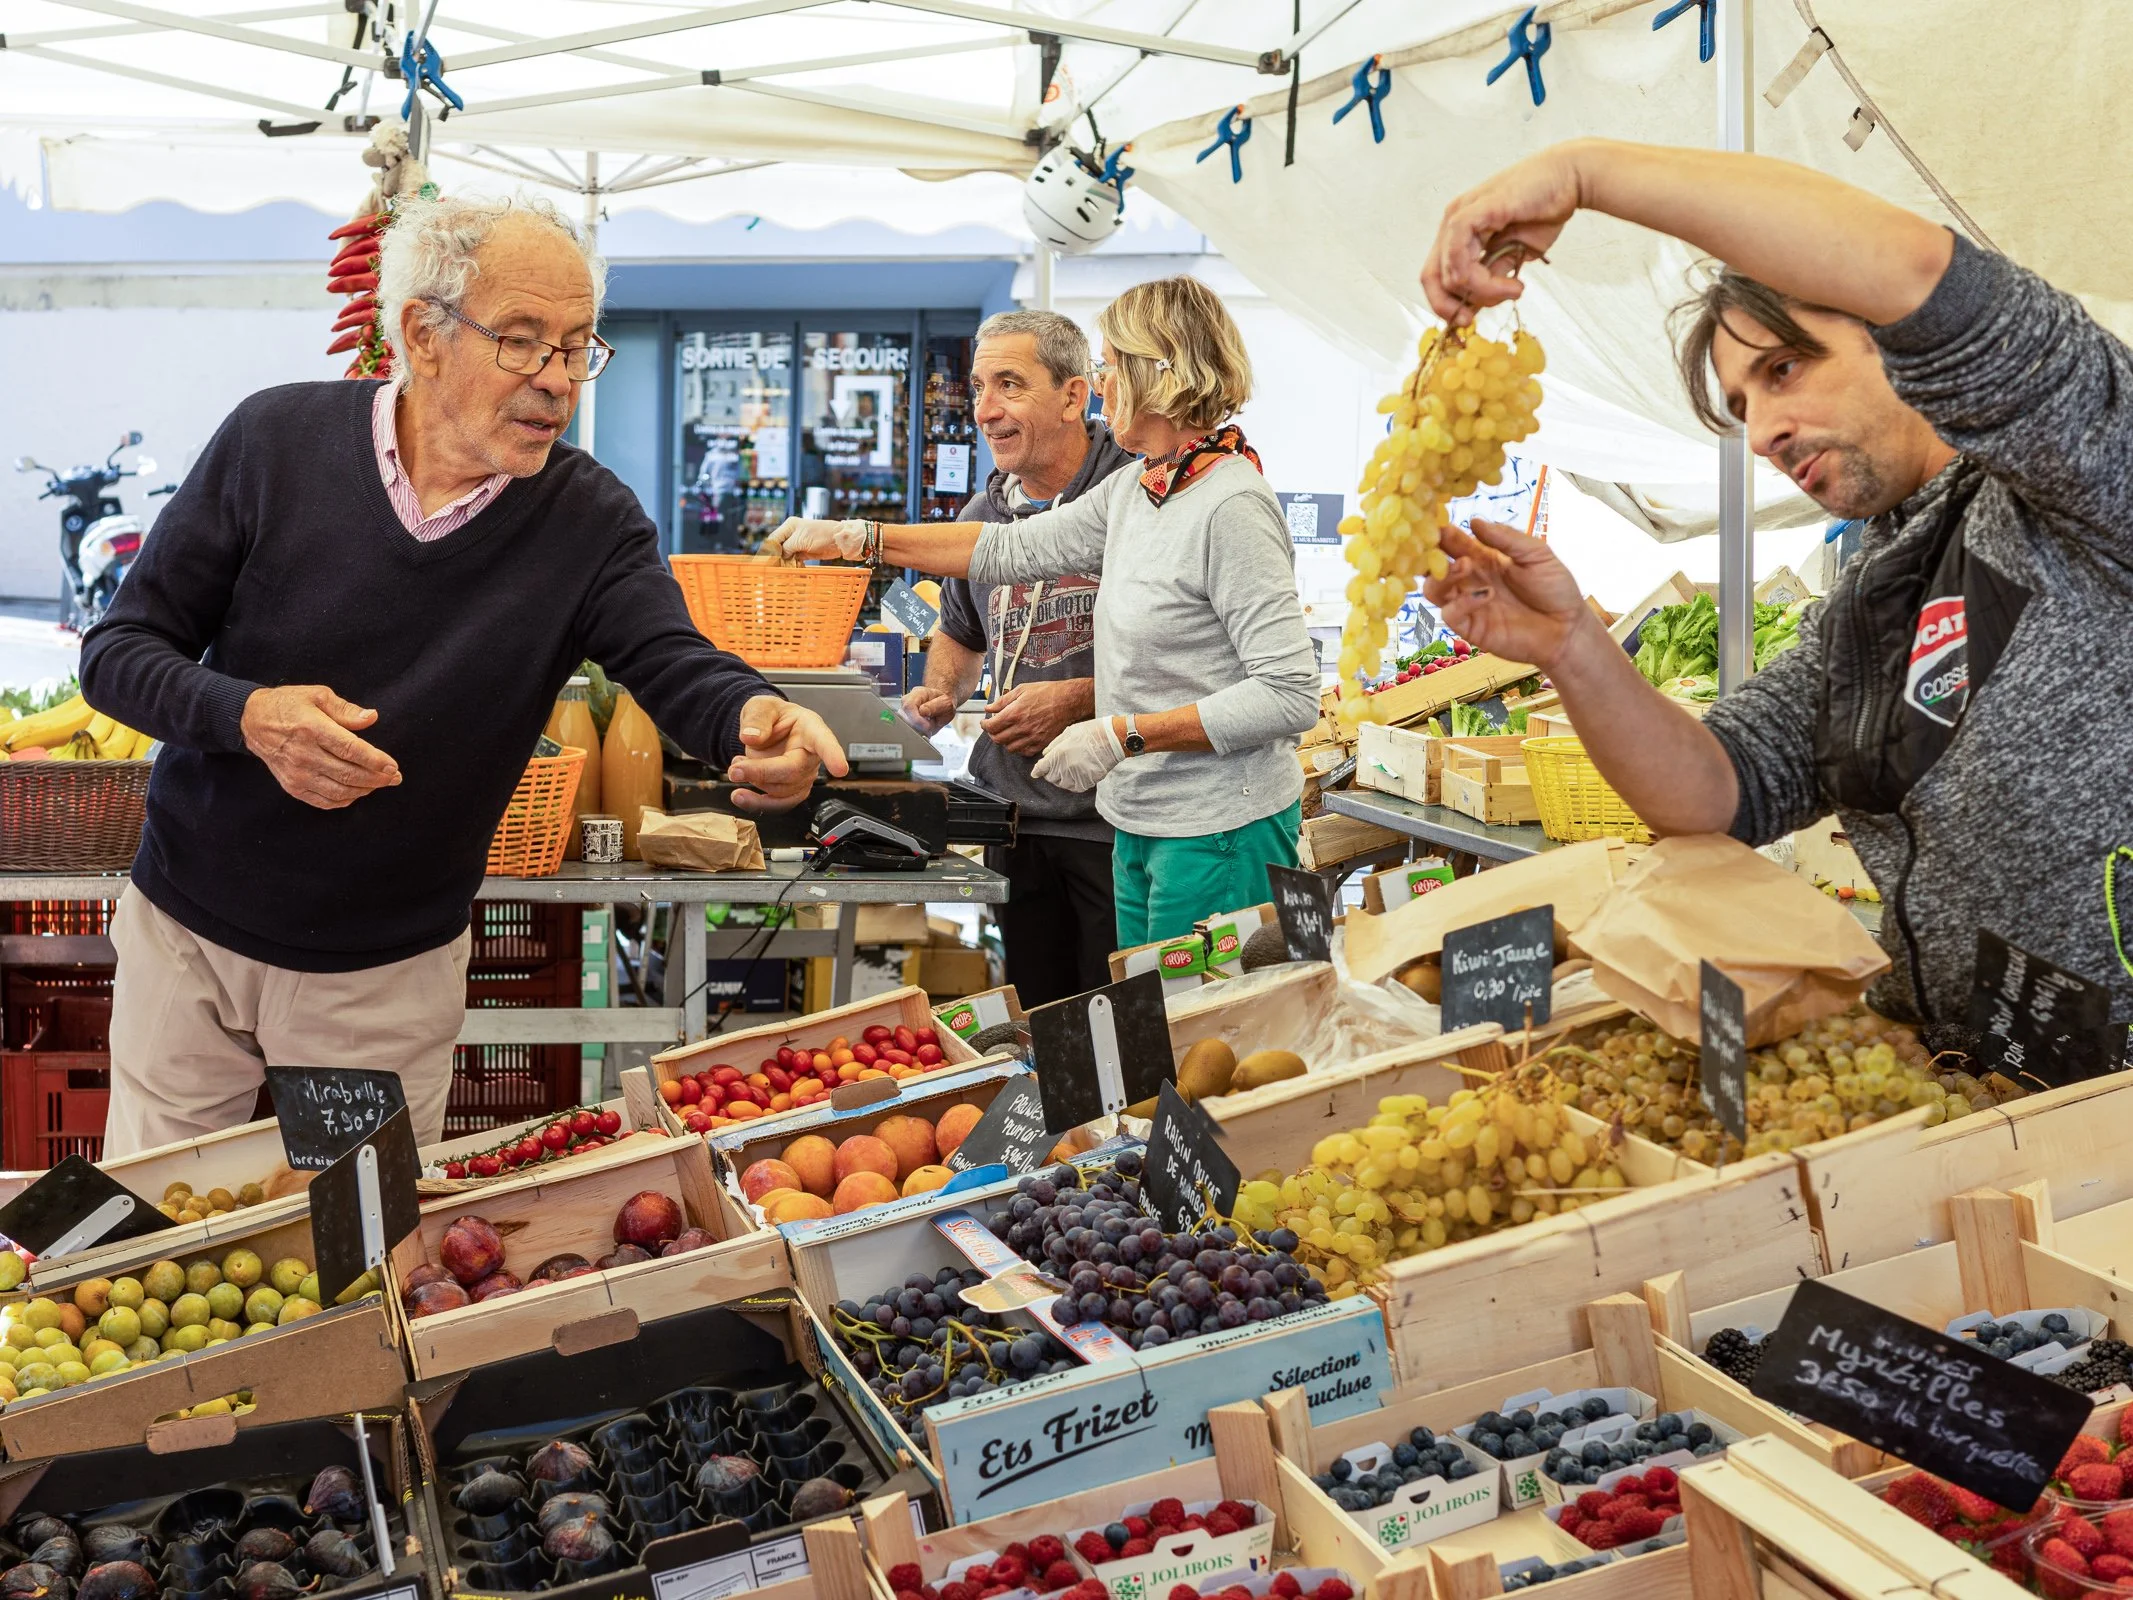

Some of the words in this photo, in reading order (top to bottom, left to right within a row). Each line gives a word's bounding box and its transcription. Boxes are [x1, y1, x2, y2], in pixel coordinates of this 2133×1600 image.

[682, 347, 754, 369] SORTIE
[758, 346, 787, 369] DE
[814, 348, 909, 370] SECOURS
[1037, 601, 1054, 622] OIL
[1911, 612, 1967, 653] CAT
[1920, 663, 1968, 700] CORSE
[1412, 878, 1443, 894] TROPS
[1165, 951, 1193, 966] TROPS
[1218, 935, 1238, 952] TROPS
[1452, 948, 1489, 975] Kiwi
[950, 1011, 972, 1029] TROPS
[1164, 1114, 1192, 1164] RAISIN
[1166, 1154, 1179, 1180] DE
[1138, 1187, 1162, 1222] FRANCE
[946, 1220, 1001, 1266] Sélection
[1196, 1332, 1251, 1350] Monts
[1273, 1306, 1342, 1328] Vaucluse
[1269, 1352, 1361, 1394] Sélection
[1808, 1325, 2005, 1429] Myrtilles
[961, 1396, 994, 1410] Ets
[1001, 1373, 1070, 1396] Frizet
[979, 1438, 1033, 1480] Ets
[1043, 1389, 1159, 1453] Frizet
[1412, 1486, 1491, 1525] JOLIBOIS
[766, 1551, 797, 1566] FRANCE
[1150, 1553, 1234, 1586] JOLIBOIS
